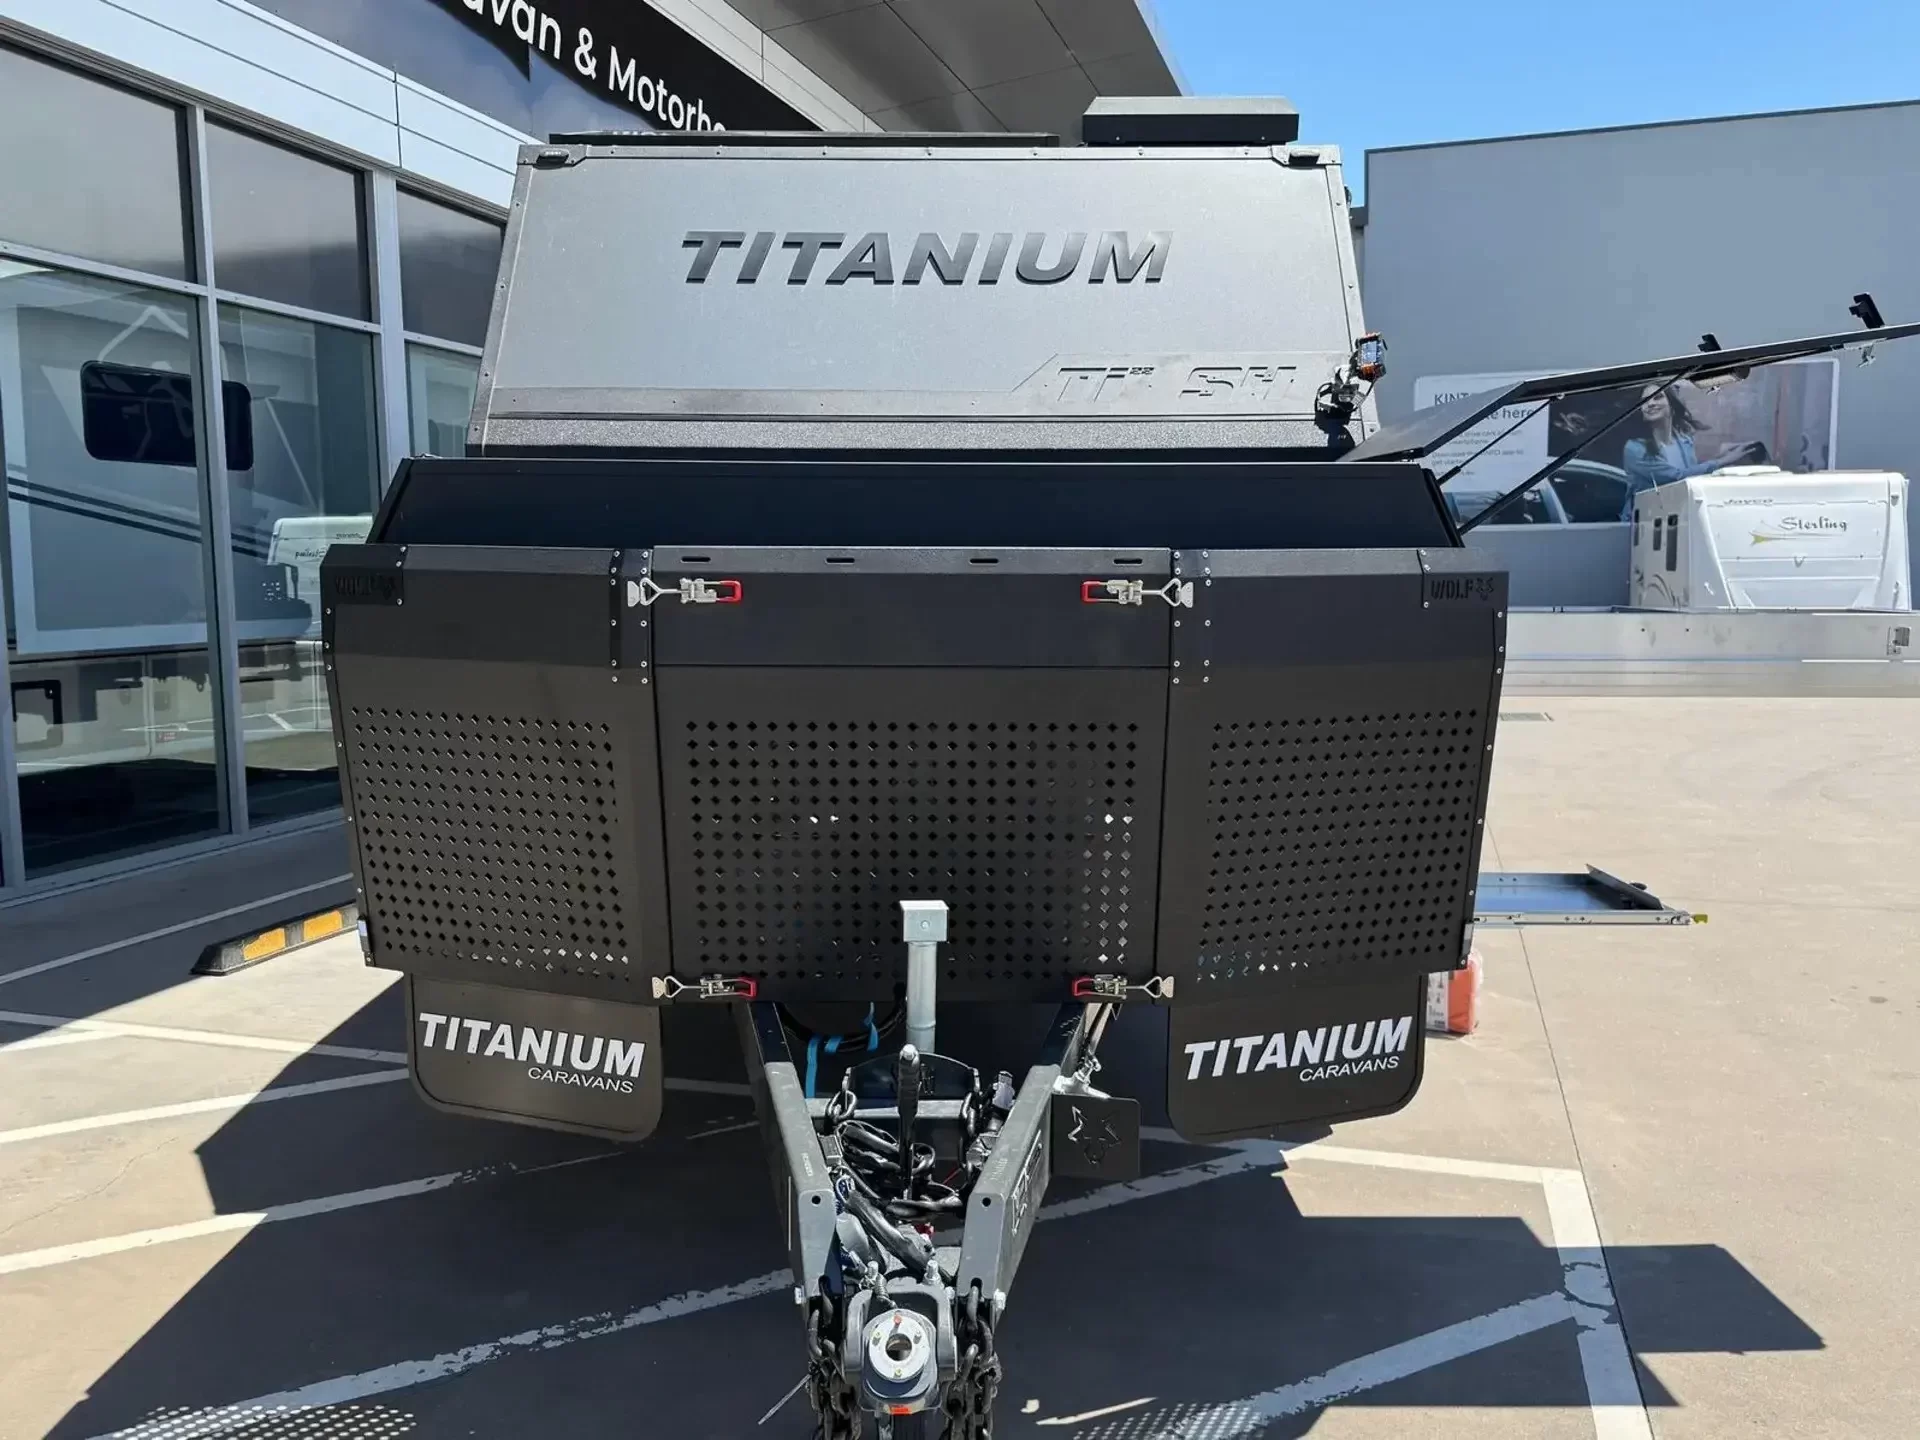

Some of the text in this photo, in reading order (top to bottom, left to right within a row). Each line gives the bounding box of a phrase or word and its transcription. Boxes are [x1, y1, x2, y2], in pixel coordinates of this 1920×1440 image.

[574, 27, 597, 80] &
[682, 231, 1174, 285] TITANIUM
[1434, 392, 1470, 405] KINT
[1777, 515, 1848, 532] Sterling
[1431, 578, 1473, 600] WOLF
[419, 1012, 645, 1078] TITANIUM
[1184, 1016, 1412, 1081] TITANIUM
[528, 1067, 634, 1094] CARAVANS
[1300, 1055, 1399, 1082] CARAVANS
